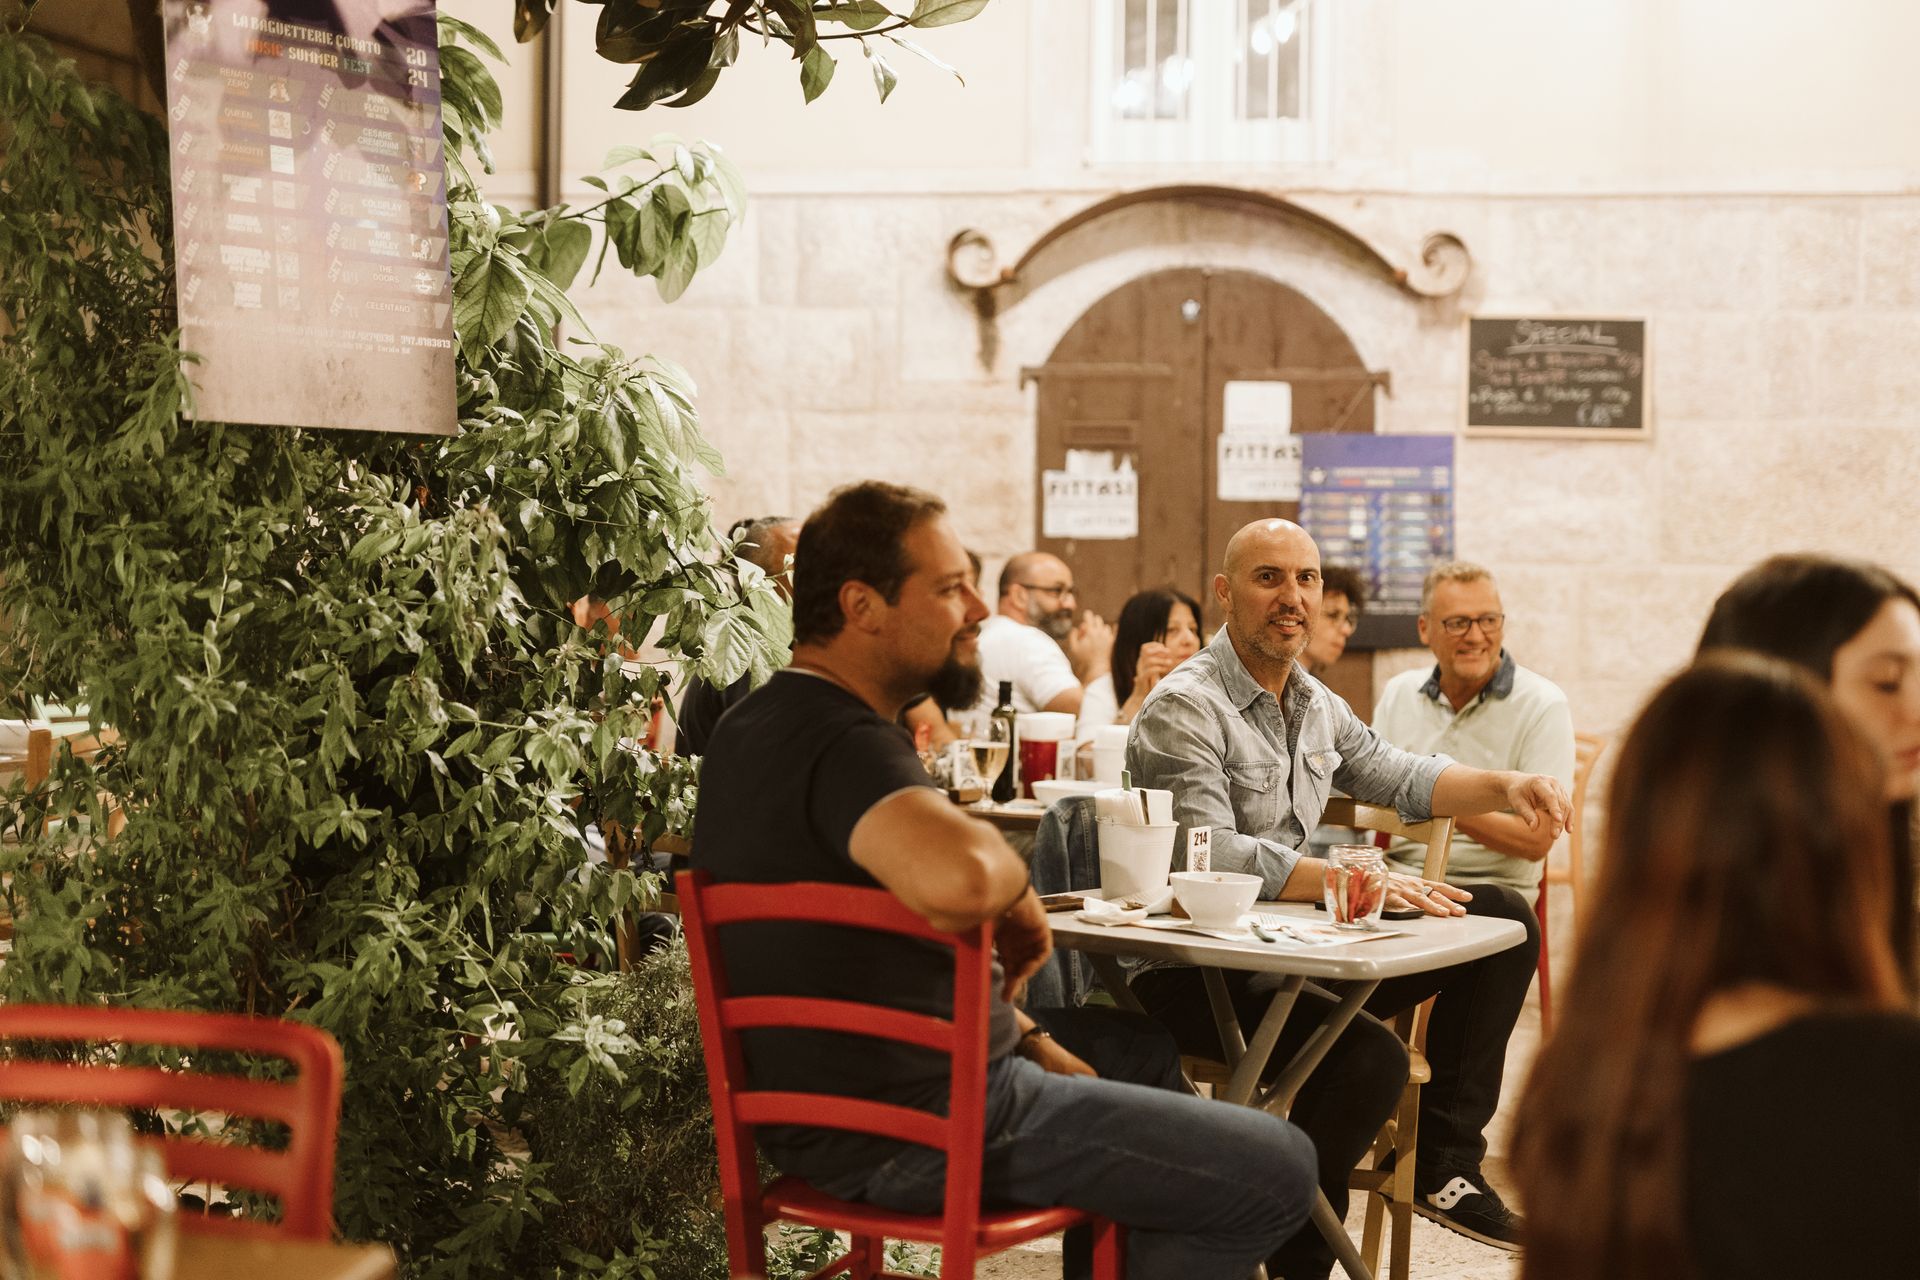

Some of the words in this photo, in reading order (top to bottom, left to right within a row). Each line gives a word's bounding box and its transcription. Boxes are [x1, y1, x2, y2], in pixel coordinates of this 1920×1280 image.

[232, 13, 248, 28] LA
[251, 17, 333, 46] BAGUETTERIE
[336, 35, 381, 56] CORATO
[288, 47, 338, 68] SUMMER
[343, 58, 372, 75] FEST
[405, 47, 427, 67] 20
[220, 67, 254, 80] RENATO
[408, 68, 429, 88] 24
[372, 272, 400, 284] DOORS
[379, 265, 393, 275] THE
[1224, 444, 1302, 460] FITTAS
[1194, 831, 1208, 846] 214
